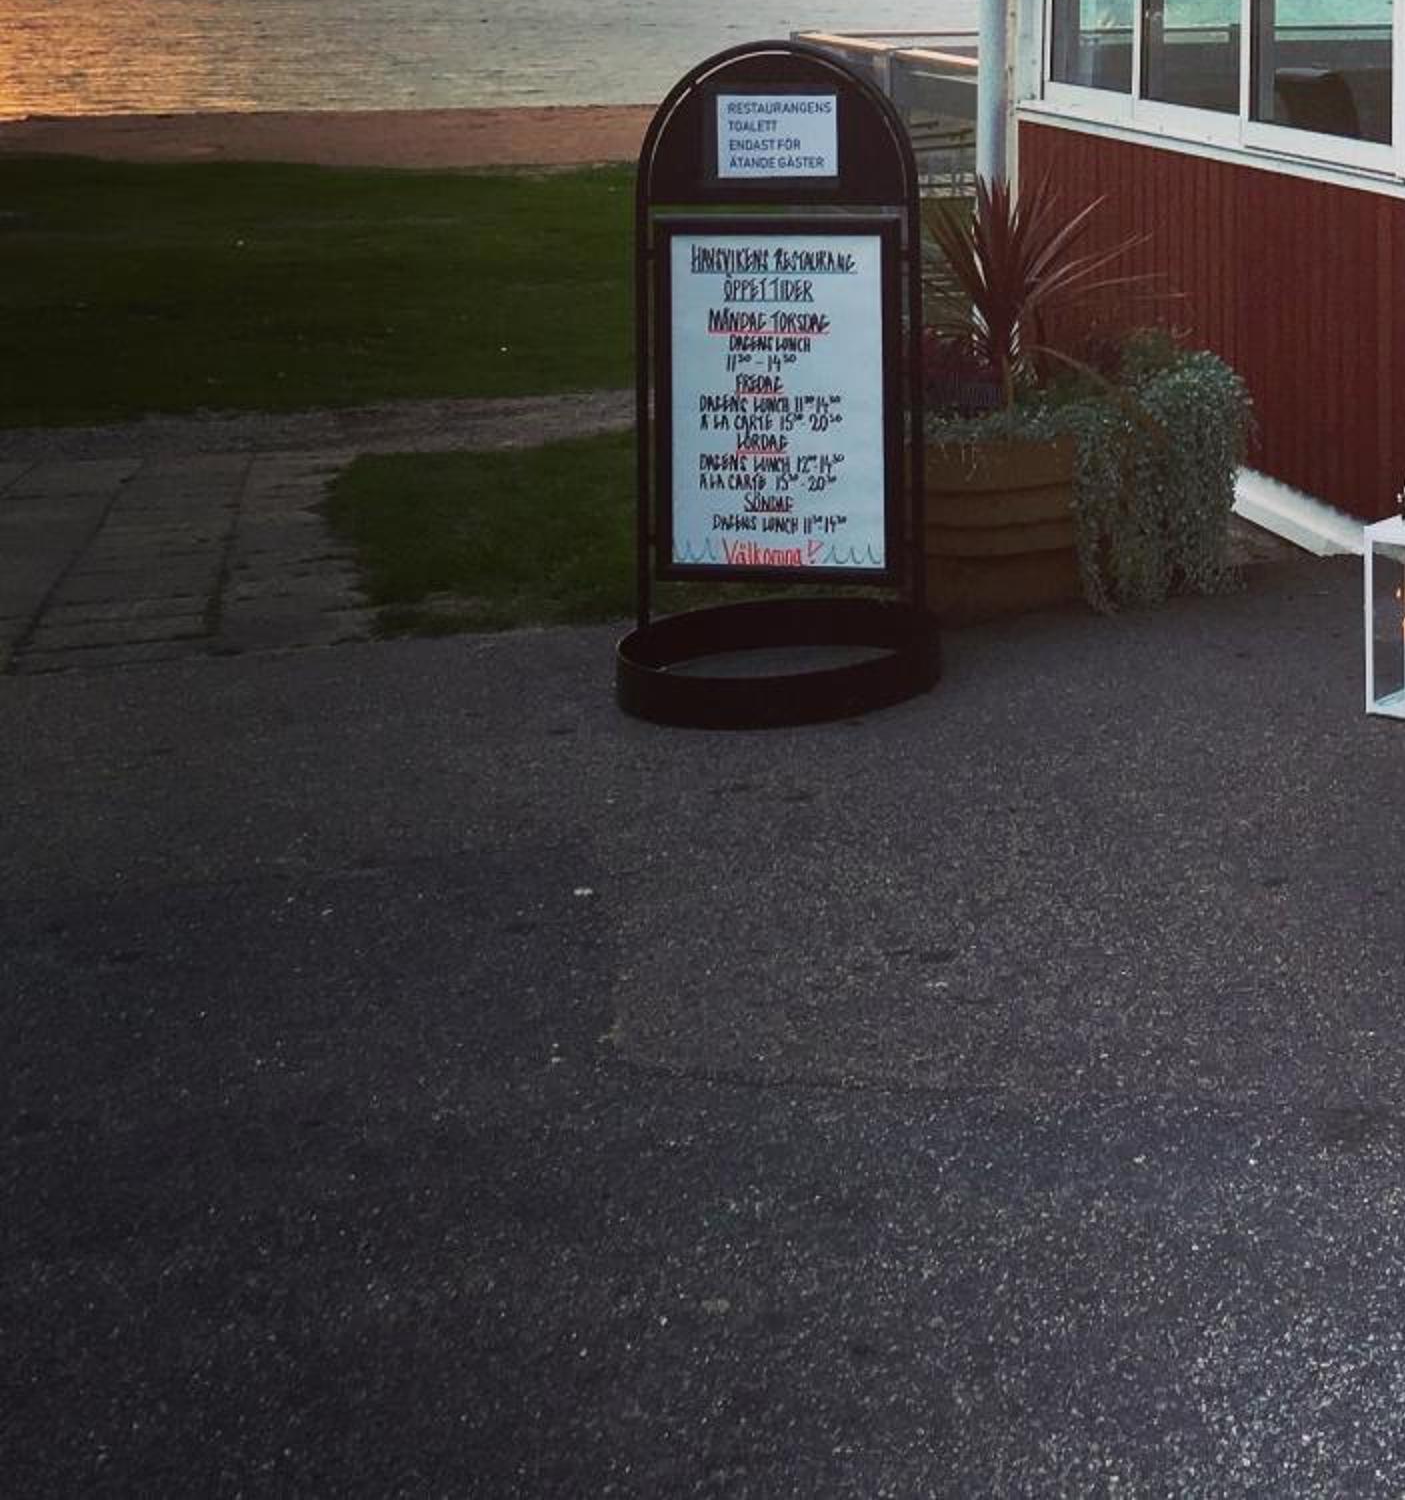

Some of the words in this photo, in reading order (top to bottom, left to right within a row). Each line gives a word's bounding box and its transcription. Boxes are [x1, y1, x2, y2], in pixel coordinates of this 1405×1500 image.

[727, 101, 832, 115] RESTAURANGENS
[728, 119, 777, 132] TOALETT
[729, 138, 775, 151] ENDAST
[777, 137, 801, 151] FÖR
[778, 155, 825, 169] GÄSTER
[723, 274, 767, 301] ÖPPET
[769, 278, 813, 301] TIDER
[729, 335, 772, 352] DAGENS
[775, 336, 811, 352] LUNCH
[735, 374, 783, 392] FREDAG
[699, 395, 747, 412] DAGENS
[753, 397, 790, 412] LUNCH
[734, 414, 772, 432] CARTE
[699, 453, 747, 472] DAGENS
[753, 455, 791, 472] LUNCH
[712, 514, 757, 531] DAGENS
[762, 516, 799, 533] LUNCH
